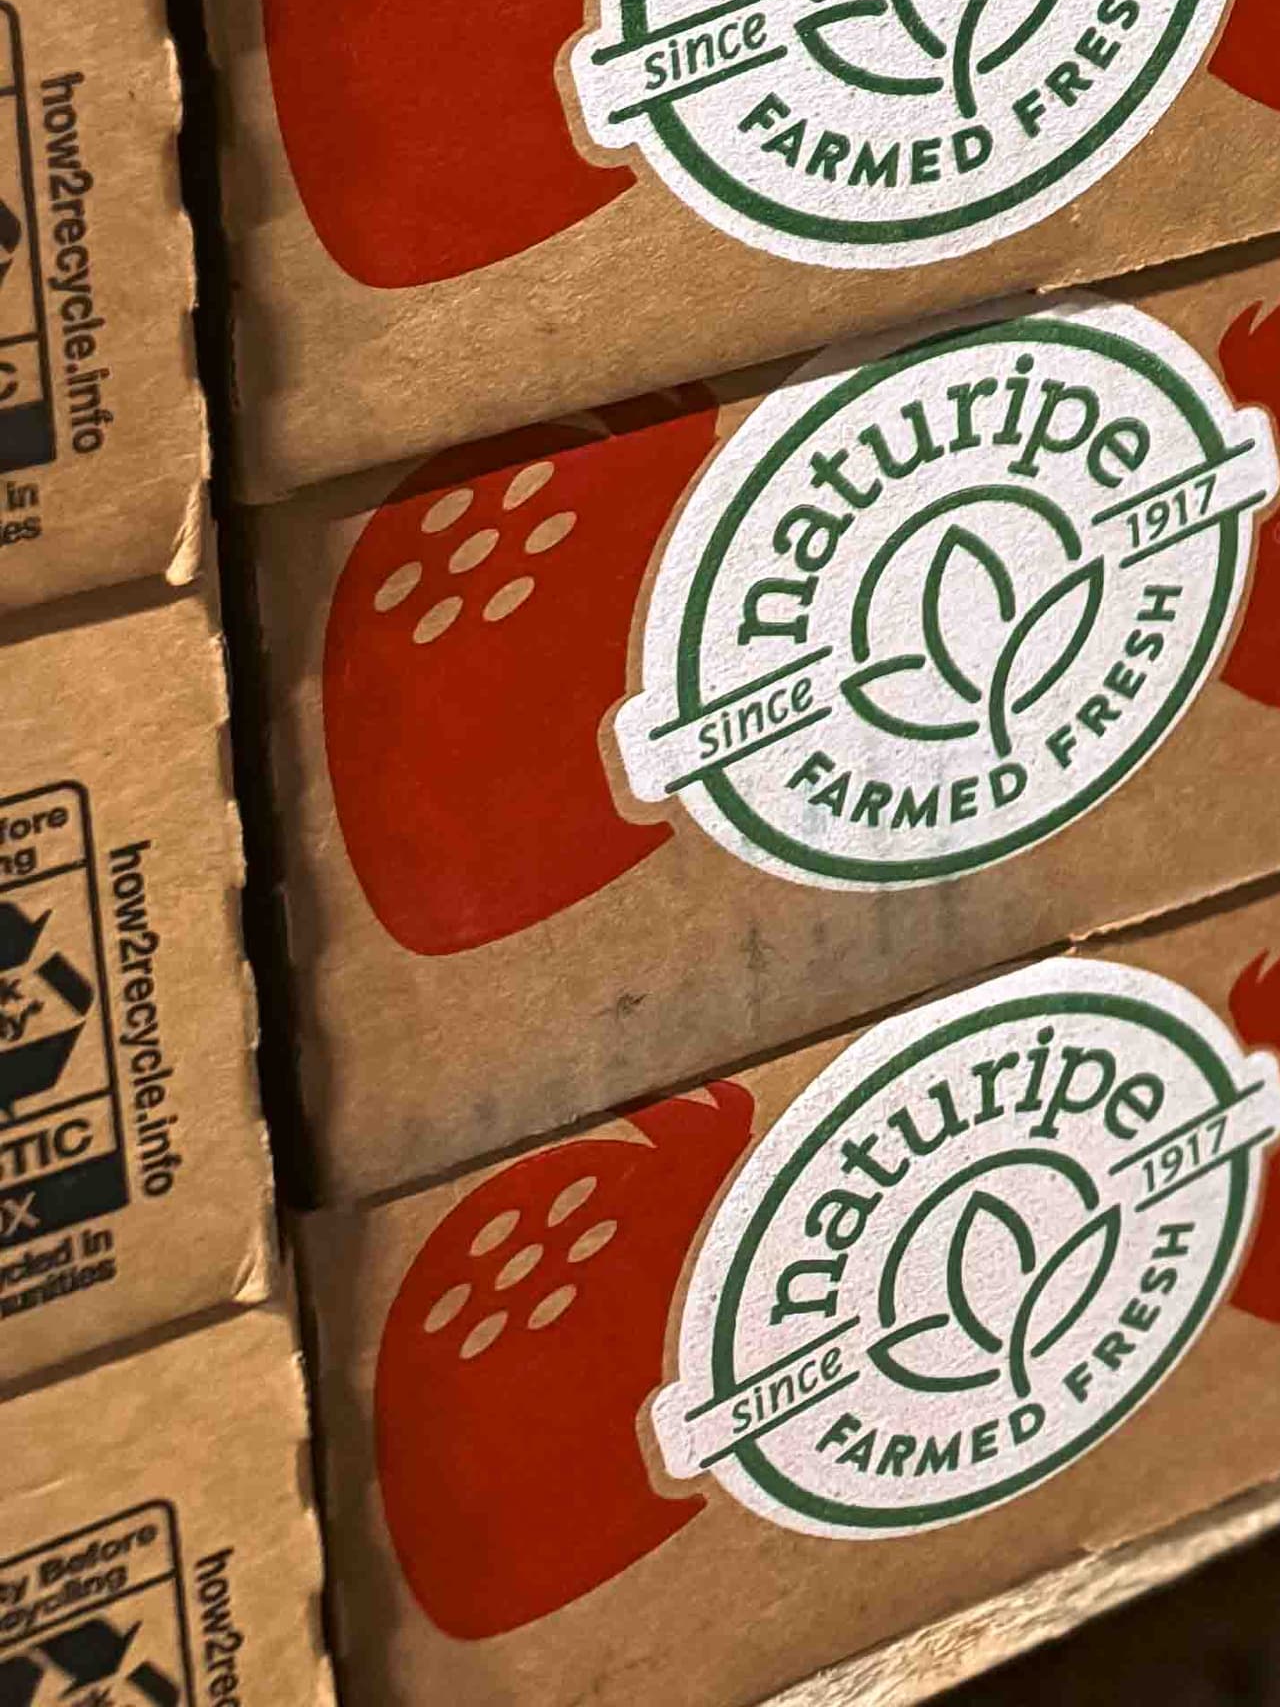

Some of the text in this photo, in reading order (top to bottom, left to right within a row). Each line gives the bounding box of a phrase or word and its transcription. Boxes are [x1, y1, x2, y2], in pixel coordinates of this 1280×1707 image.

[643, 10, 768, 91] since
[738, 92, 993, 189] FARMED
[41, 71, 114, 454] how2recycle.info
[699, 475, 1218, 760] since 1917
[737, 353, 1151, 645] naturipe
[785, 582, 1184, 829] FARMED FRESH
[109, 839, 182, 1198] how2recycle.info
[731, 1115, 1229, 1434] since 1917
[769, 1026, 1167, 1325] naturipe
[815, 1219, 1196, 1478] FARMED FRESH
